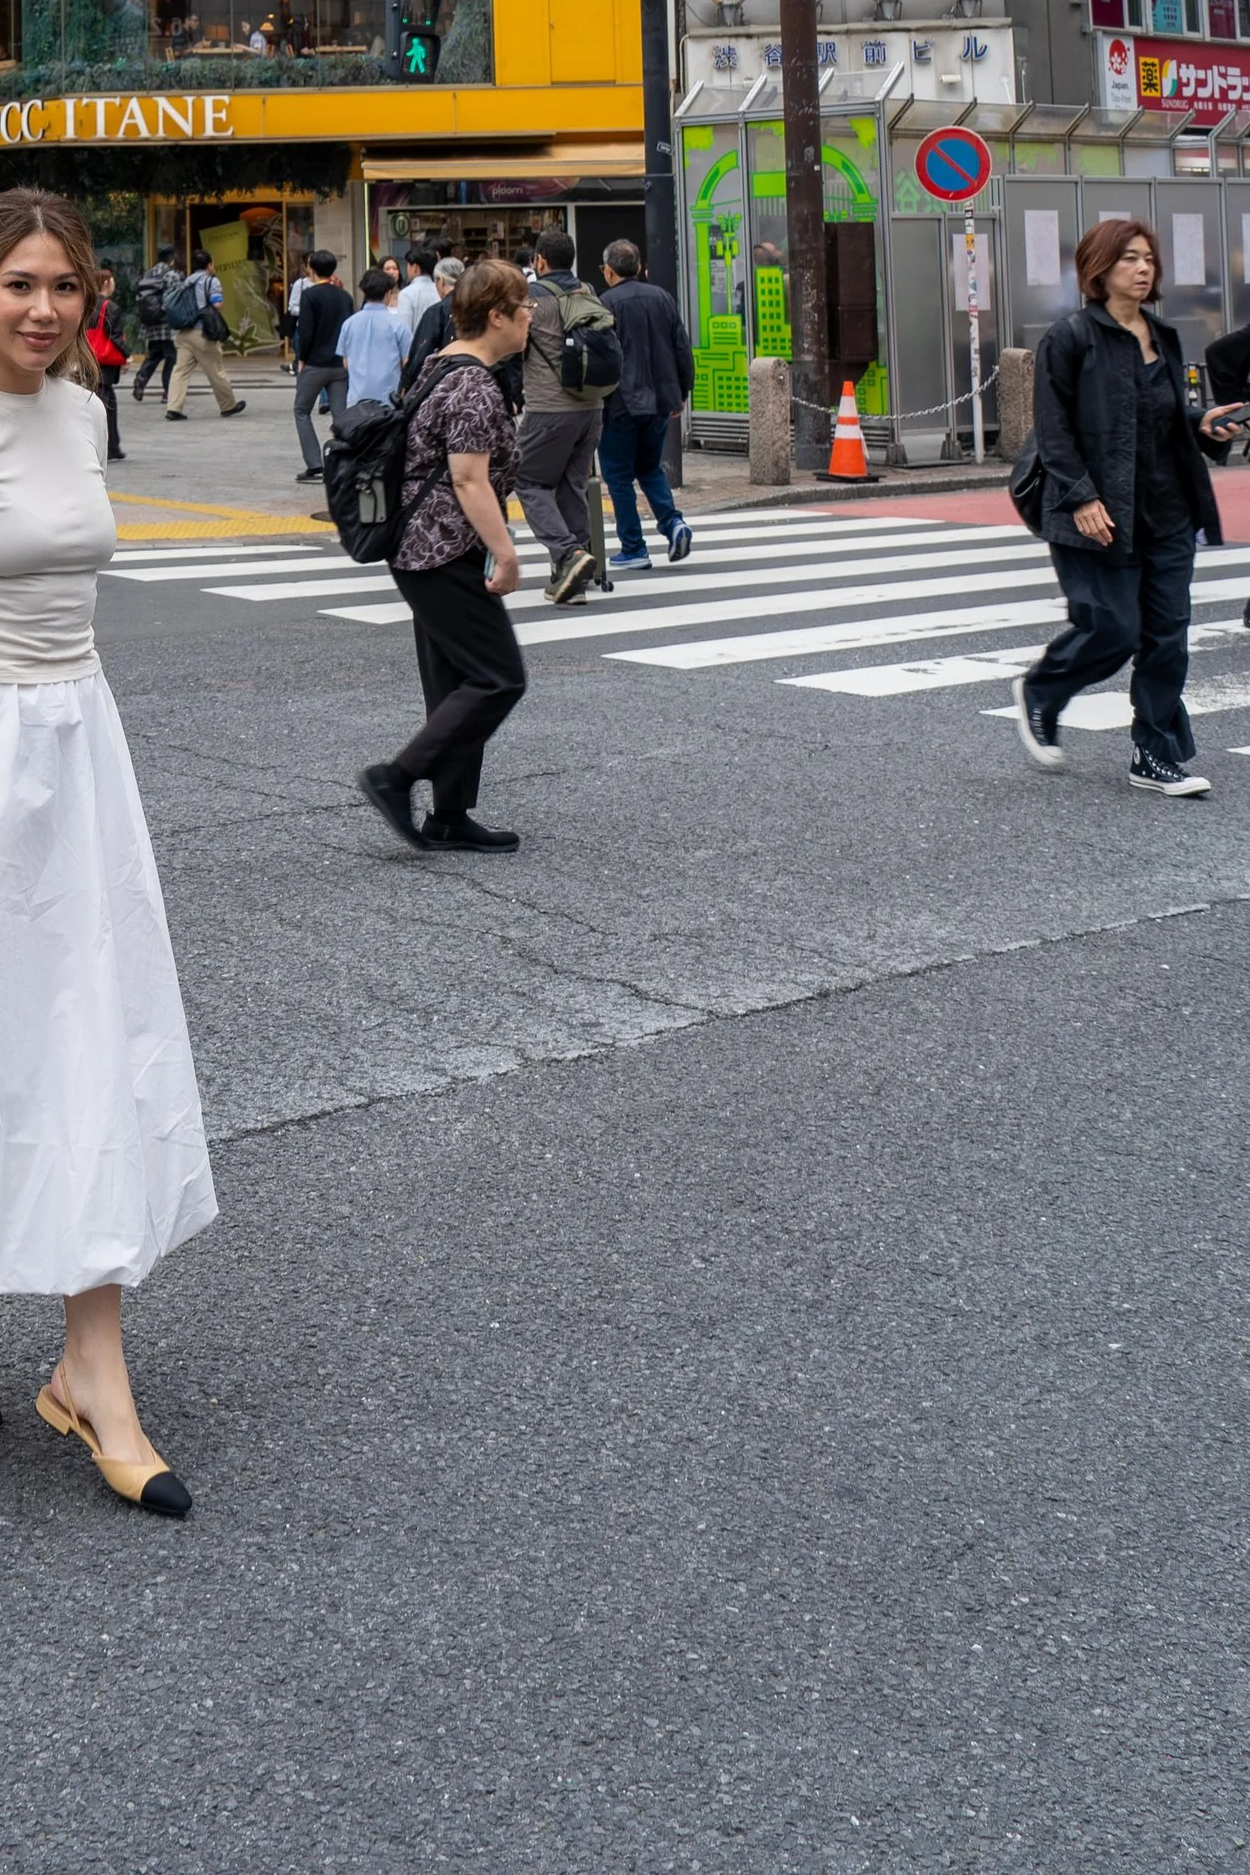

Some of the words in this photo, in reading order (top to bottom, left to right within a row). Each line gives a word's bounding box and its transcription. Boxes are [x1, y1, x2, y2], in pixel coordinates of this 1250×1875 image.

[712, 36, 988, 70] 渋谷駅前ビル
[1141, 61, 1159, 93] 薬
[491, 185, 524, 198] ploom
